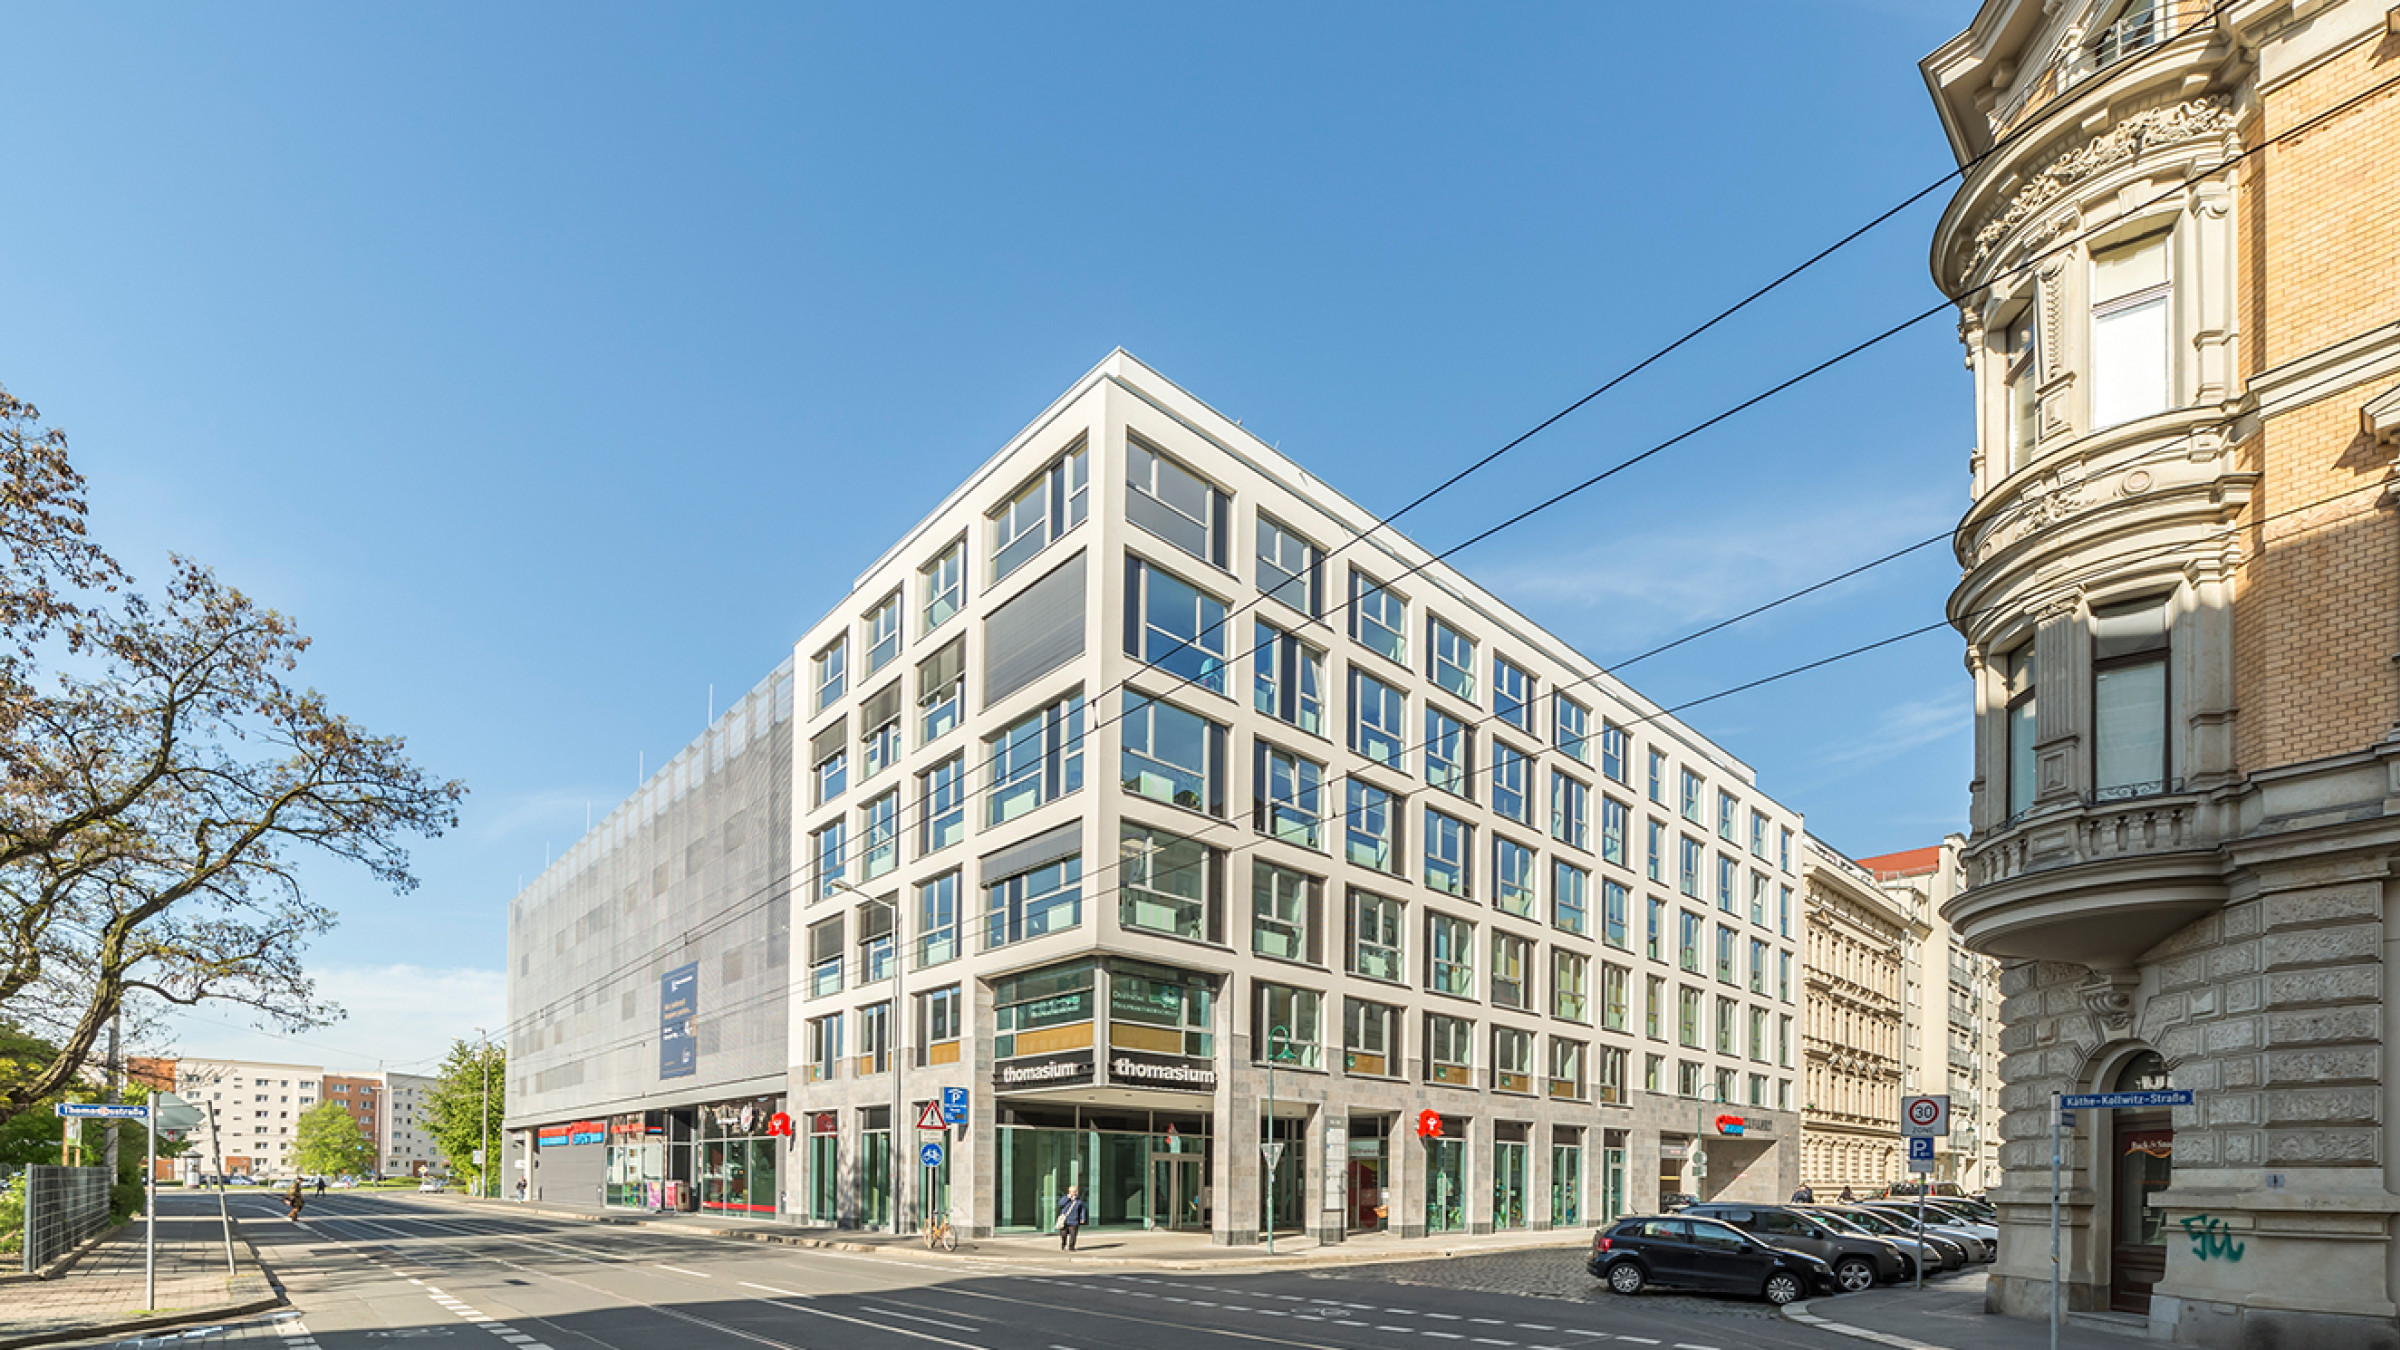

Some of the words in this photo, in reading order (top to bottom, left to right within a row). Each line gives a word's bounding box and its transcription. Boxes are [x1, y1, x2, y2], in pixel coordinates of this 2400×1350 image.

[1003, 1059, 1077, 1083] thomasium
[1114, 1057, 1215, 1083] thomasium
[952, 1092, 961, 1104] P
[2066, 1092, 2187, 1107] Käthe-Kollwitz-Straße
[1914, 1104, 1933, 1119] 30
[1912, 1139, 1927, 1157] P
